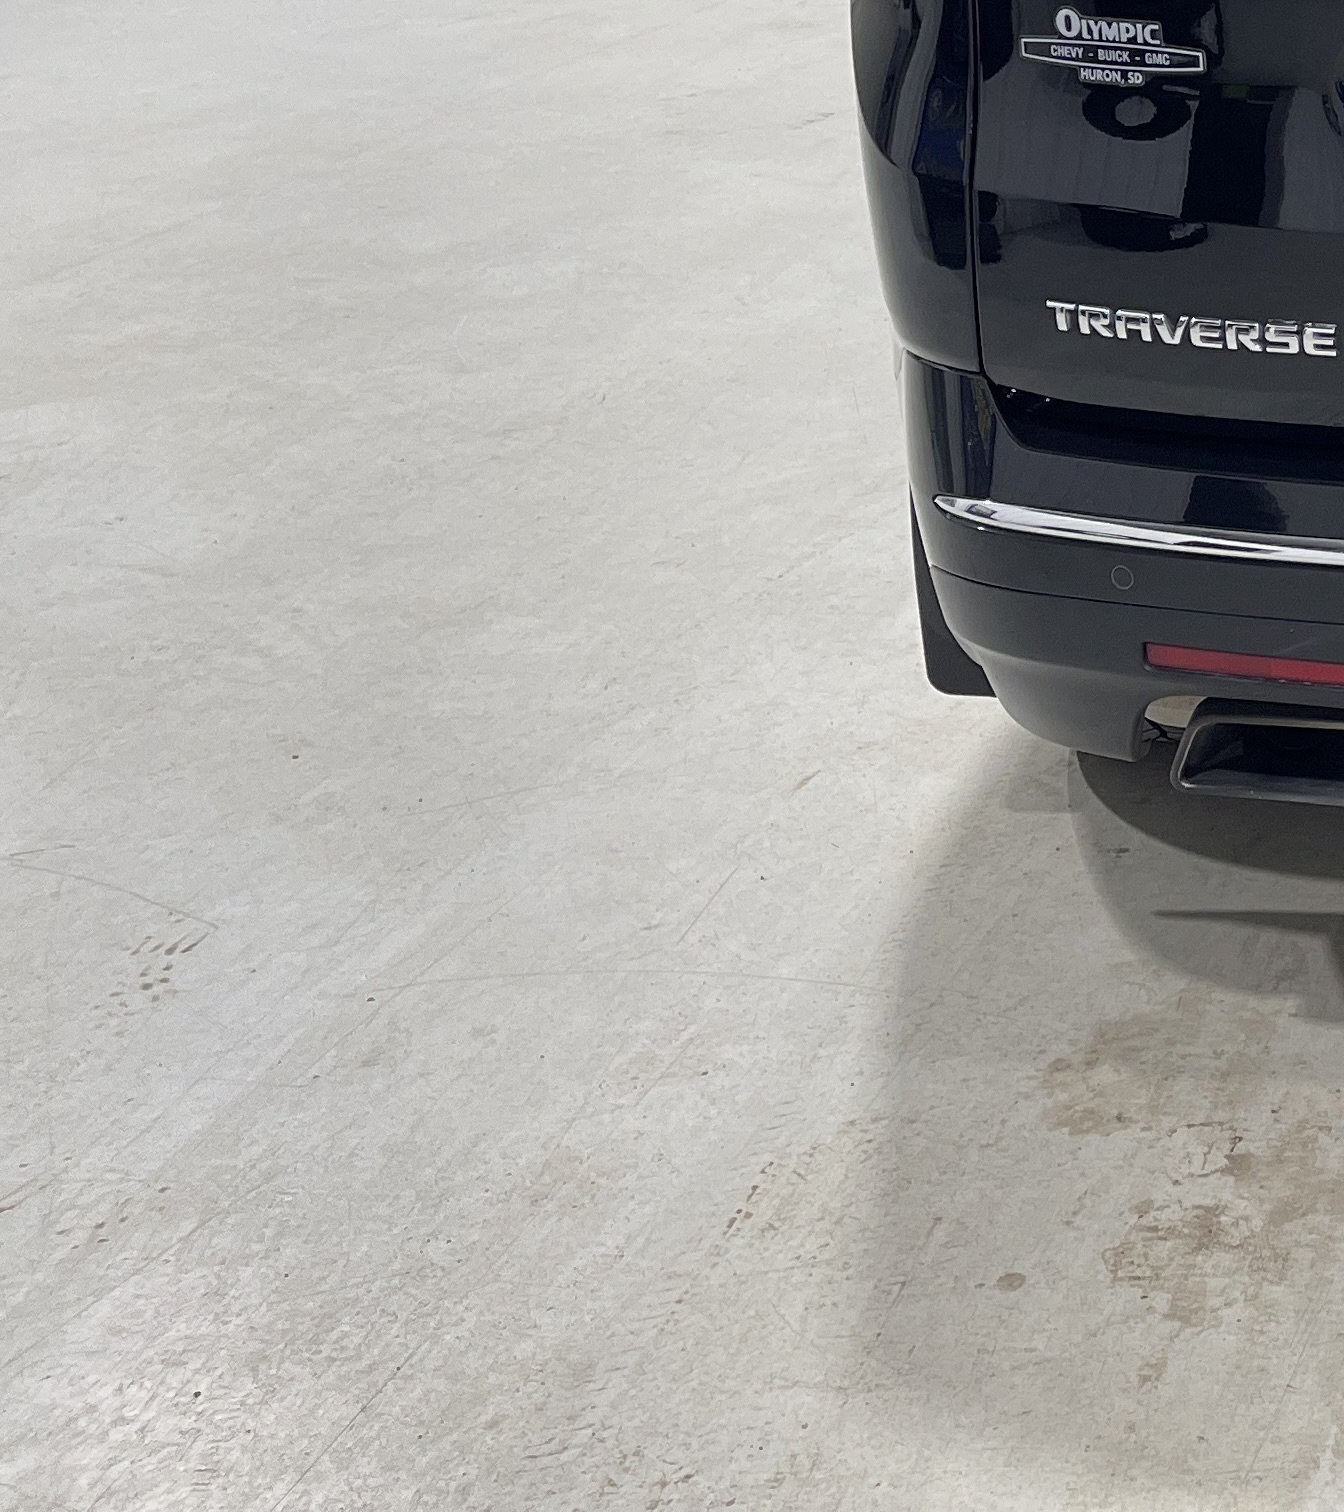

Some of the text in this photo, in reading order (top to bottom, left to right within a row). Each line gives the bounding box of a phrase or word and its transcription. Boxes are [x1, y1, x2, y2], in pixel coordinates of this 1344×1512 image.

[1051, 44, 1083, 59] CHEVY
[1097, 49, 1130, 63] BUICK
[1144, 53, 1170, 65] GMC
[1080, 68, 1143, 85] HURON, SD
[1045, 299, 1338, 357] TRAVERSE
